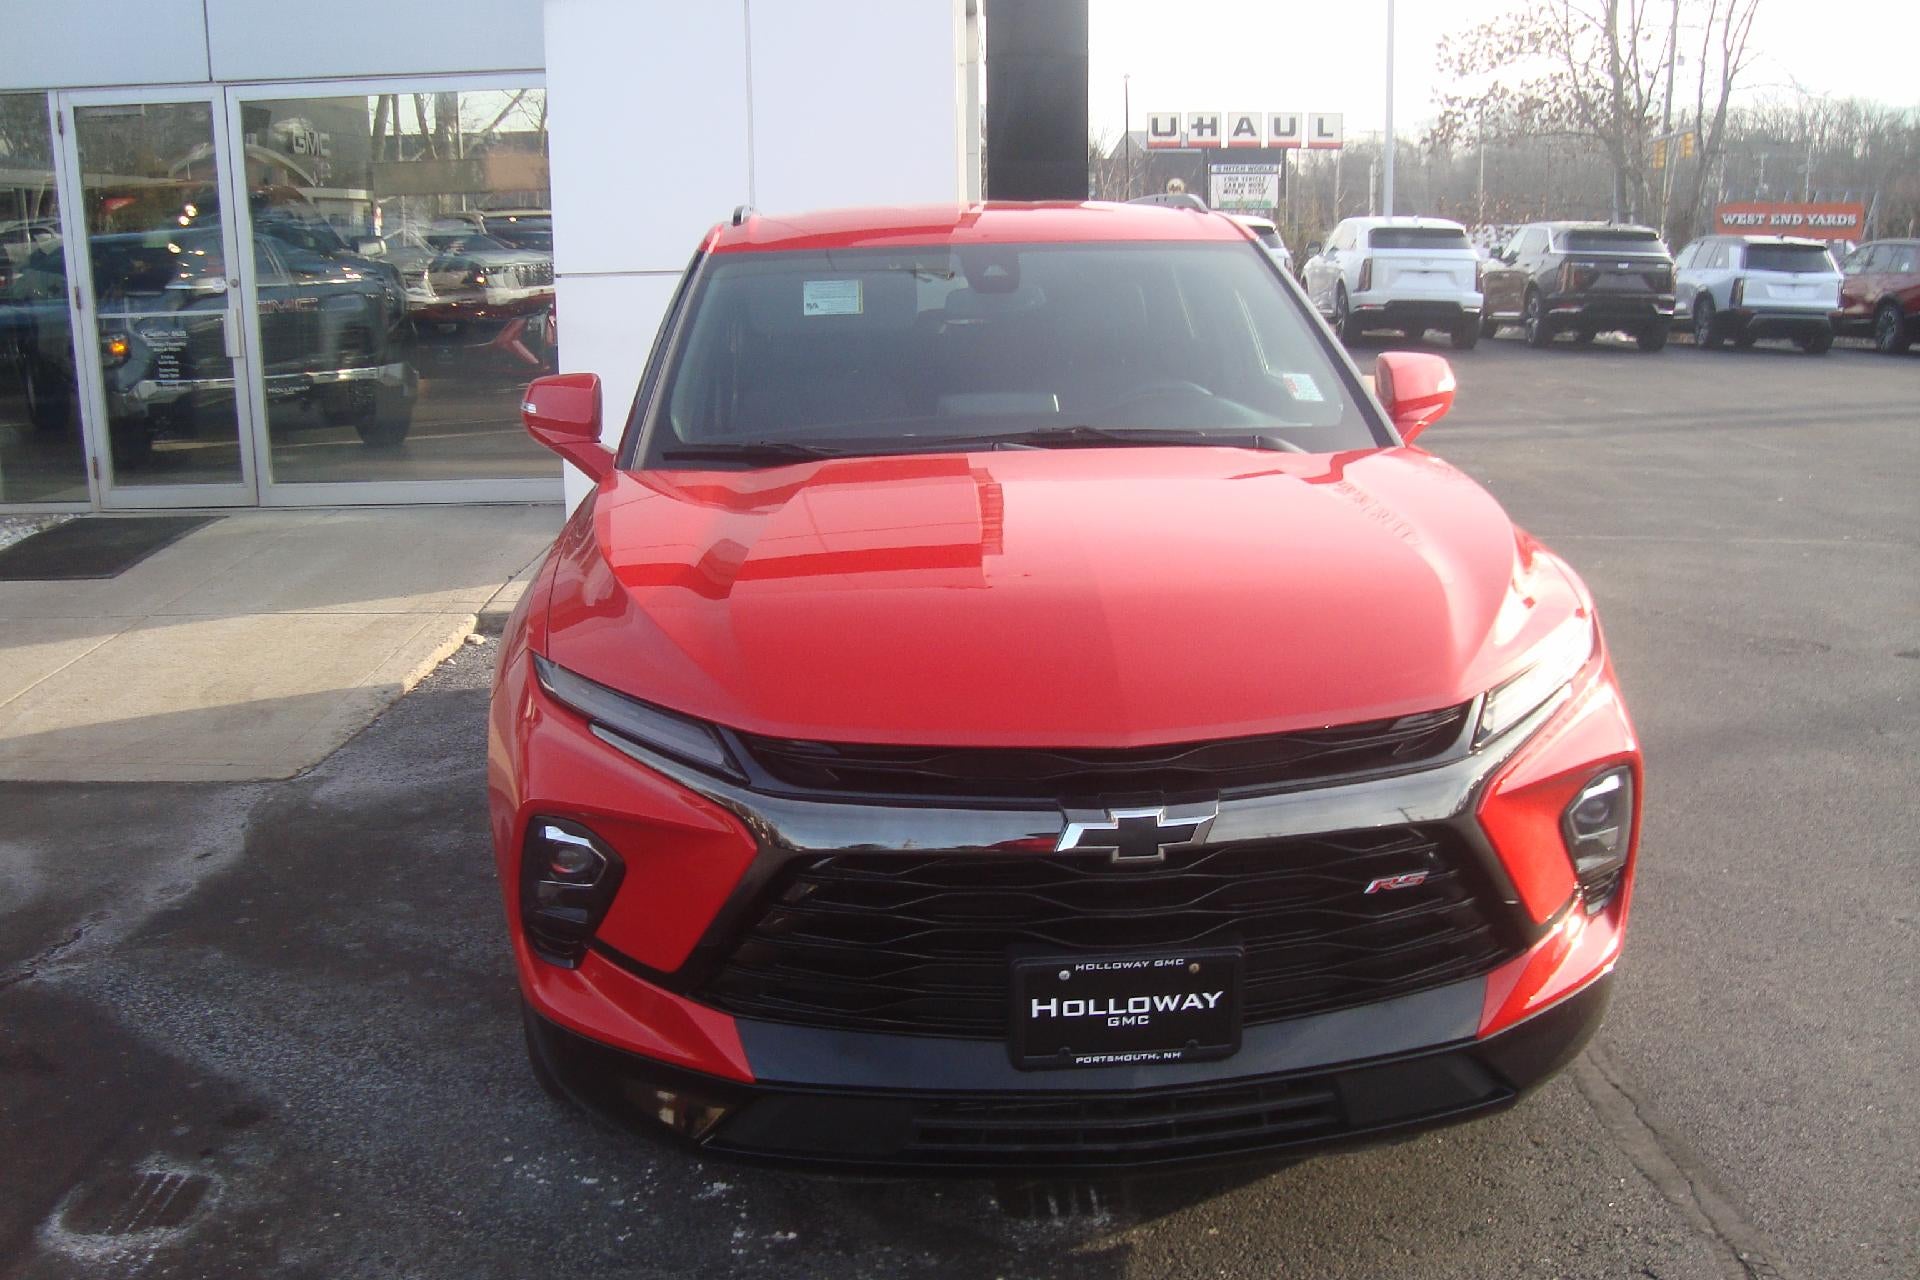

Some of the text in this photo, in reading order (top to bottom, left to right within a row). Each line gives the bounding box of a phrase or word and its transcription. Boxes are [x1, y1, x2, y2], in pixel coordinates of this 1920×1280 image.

[1722, 213, 1857, 226] WEST END YARDS
[1363, 870, 1429, 894] RS
[1075, 958, 1185, 971] HOLLOWAY GMC
[1031, 990, 1224, 1018] HOLLOWAY
[1107, 1014, 1149, 1027] GMC
[1076, 1052, 1182, 1064] PORTSMOUTH, NH
